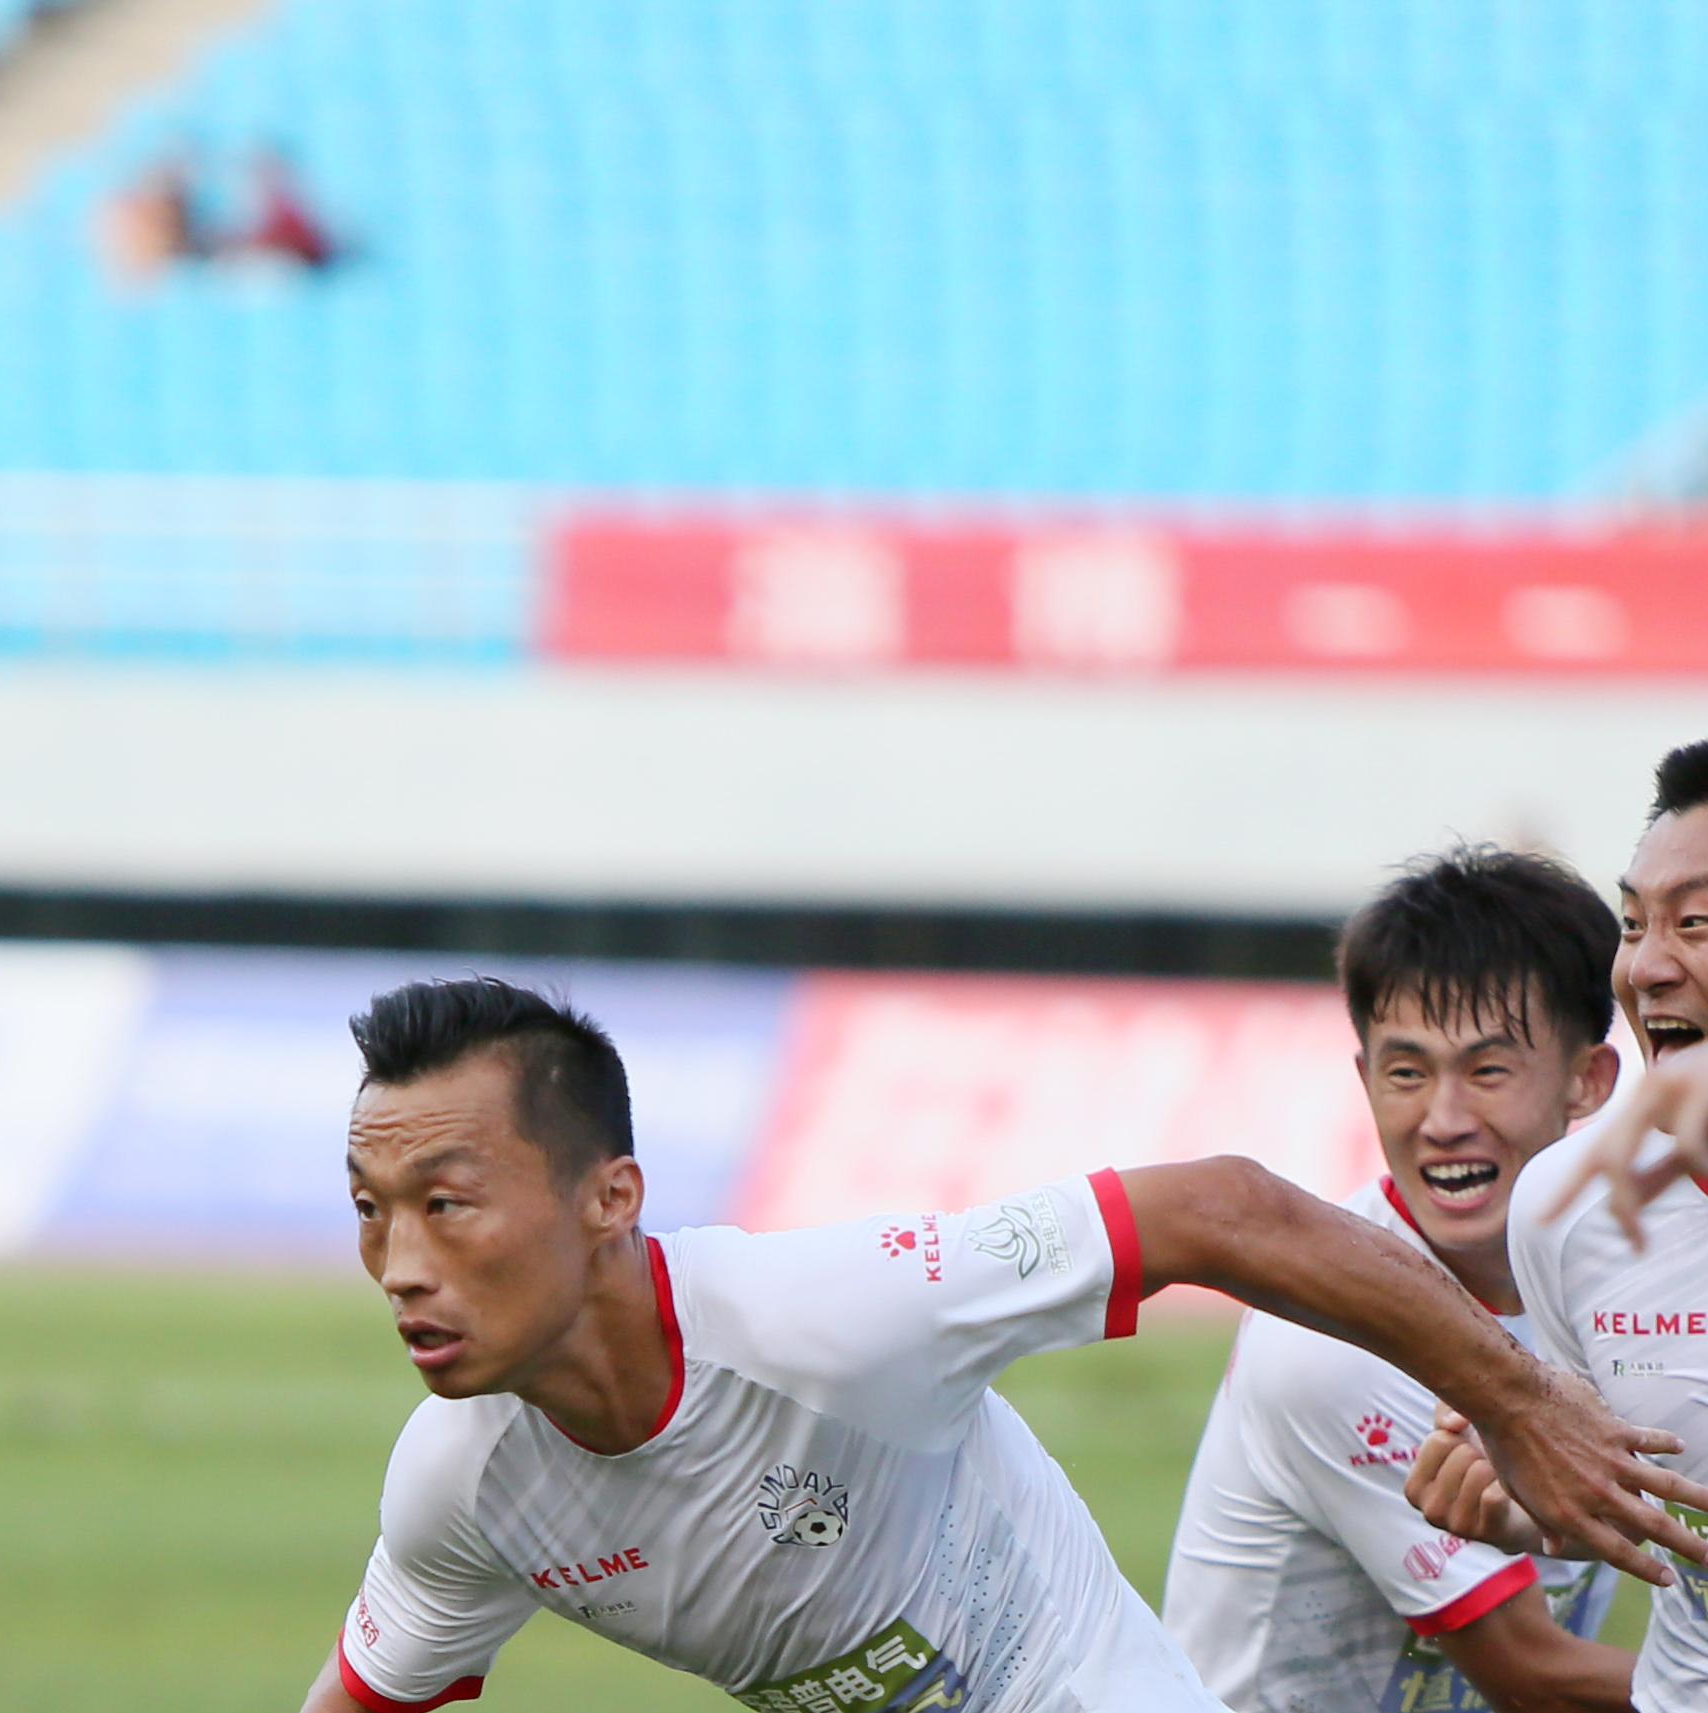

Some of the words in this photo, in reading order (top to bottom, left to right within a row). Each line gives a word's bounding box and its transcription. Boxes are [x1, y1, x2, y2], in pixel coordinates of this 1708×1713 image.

[921, 1214, 943, 1283] KELME
[1594, 1310, 1707, 1335] KELME
[531, 1547, 649, 1589] KELME
